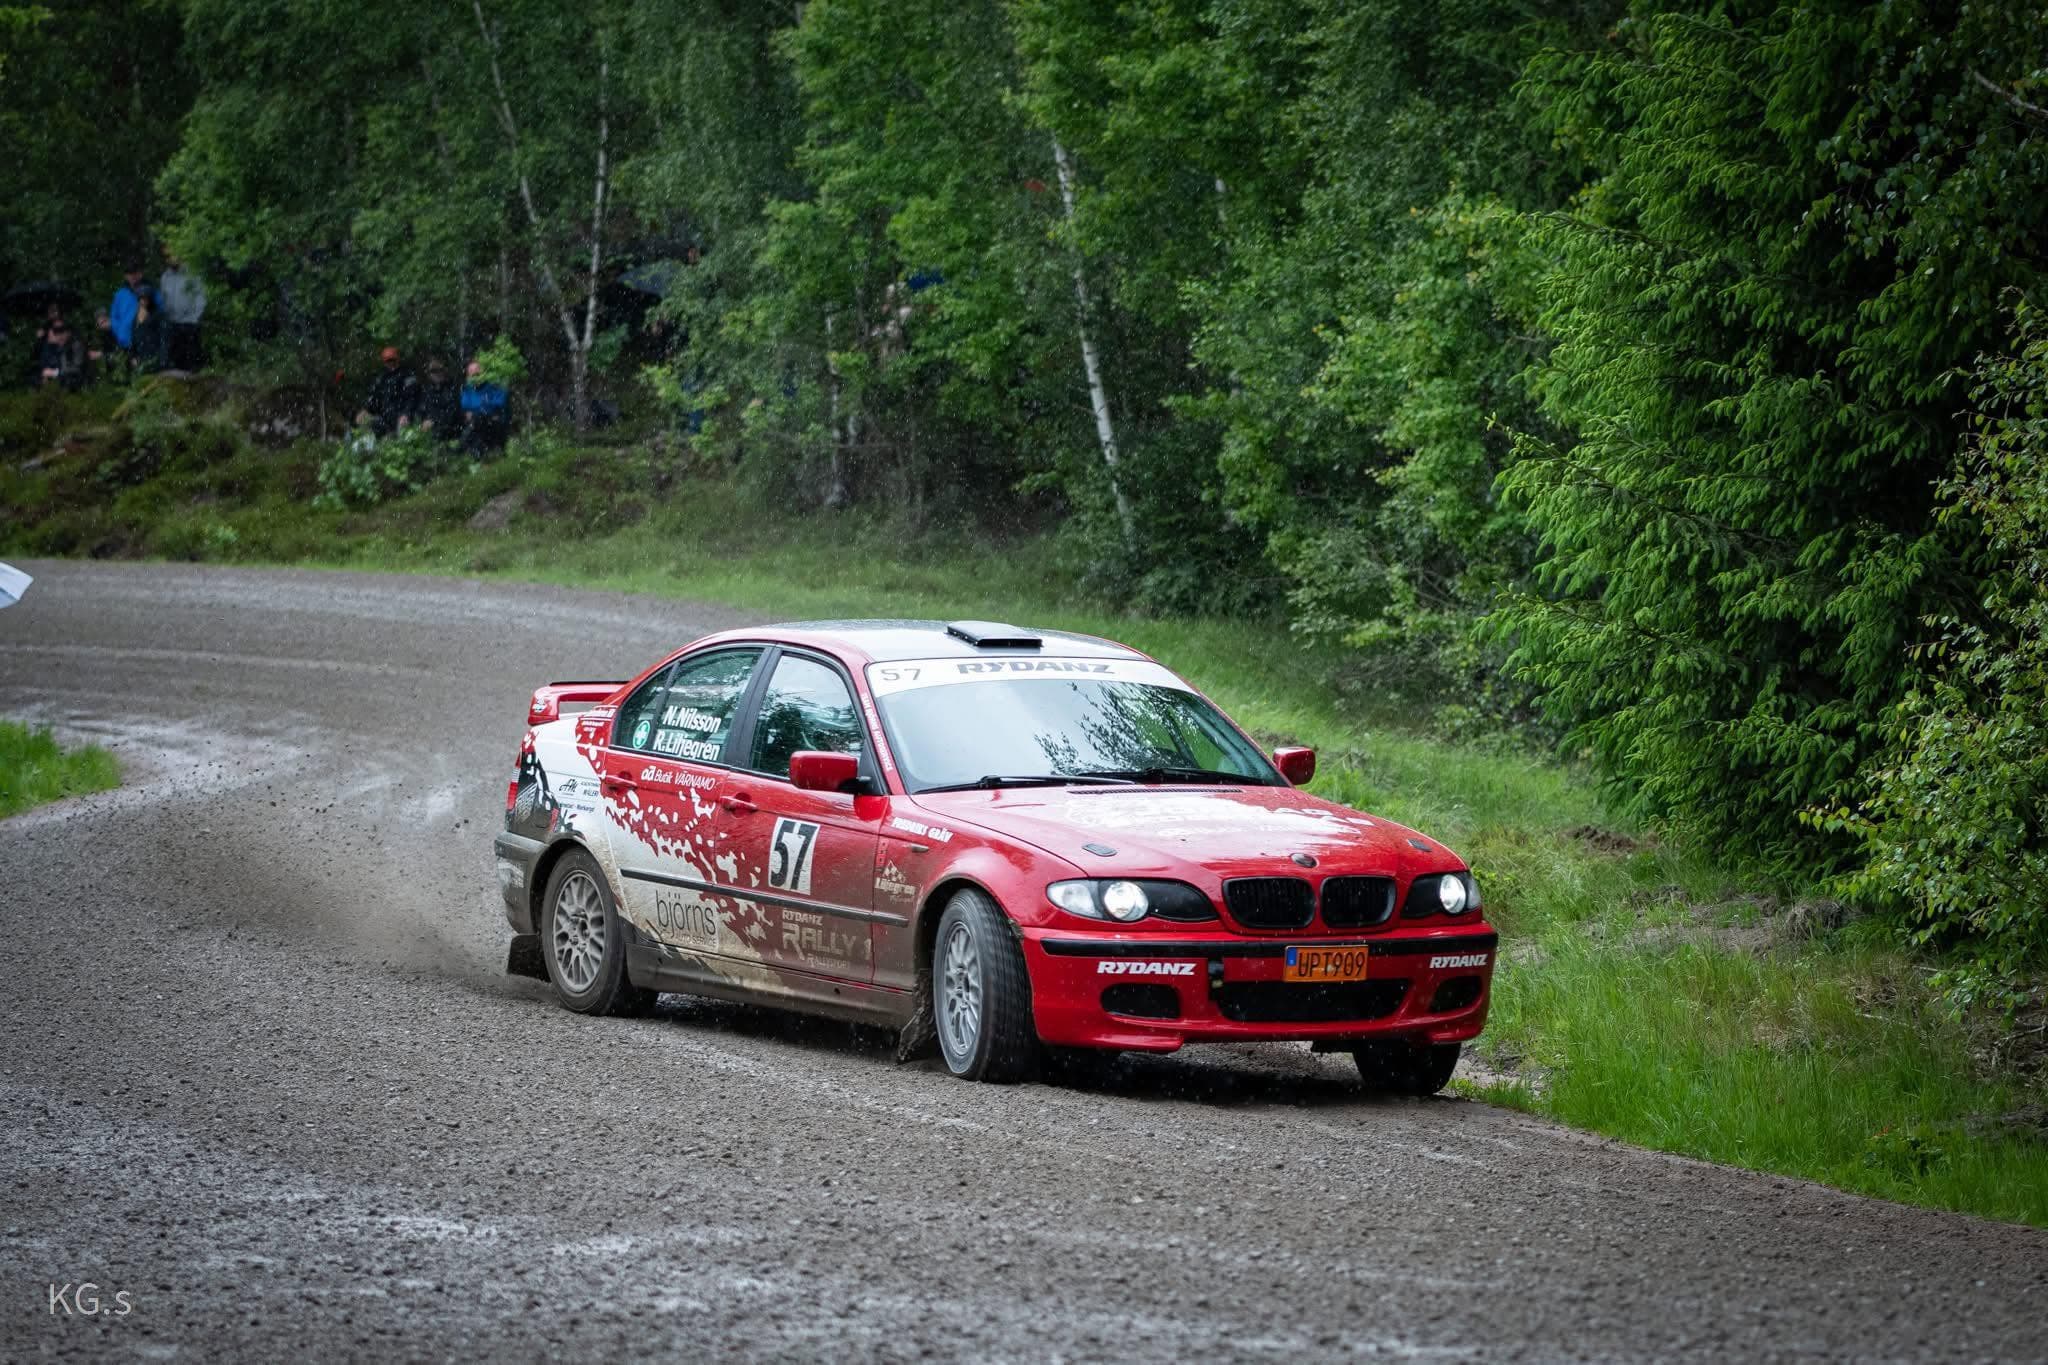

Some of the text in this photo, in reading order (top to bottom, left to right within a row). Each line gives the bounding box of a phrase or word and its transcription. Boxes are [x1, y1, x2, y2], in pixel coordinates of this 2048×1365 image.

[880, 661, 1116, 681] 57 RYDANZ
[770, 819, 818, 890] 57
[655, 890, 716, 939] björns
[1097, 961, 1198, 976] RYDANZ
[1298, 951, 1366, 978] UPT909
[1429, 954, 1488, 969] RYDANZ
